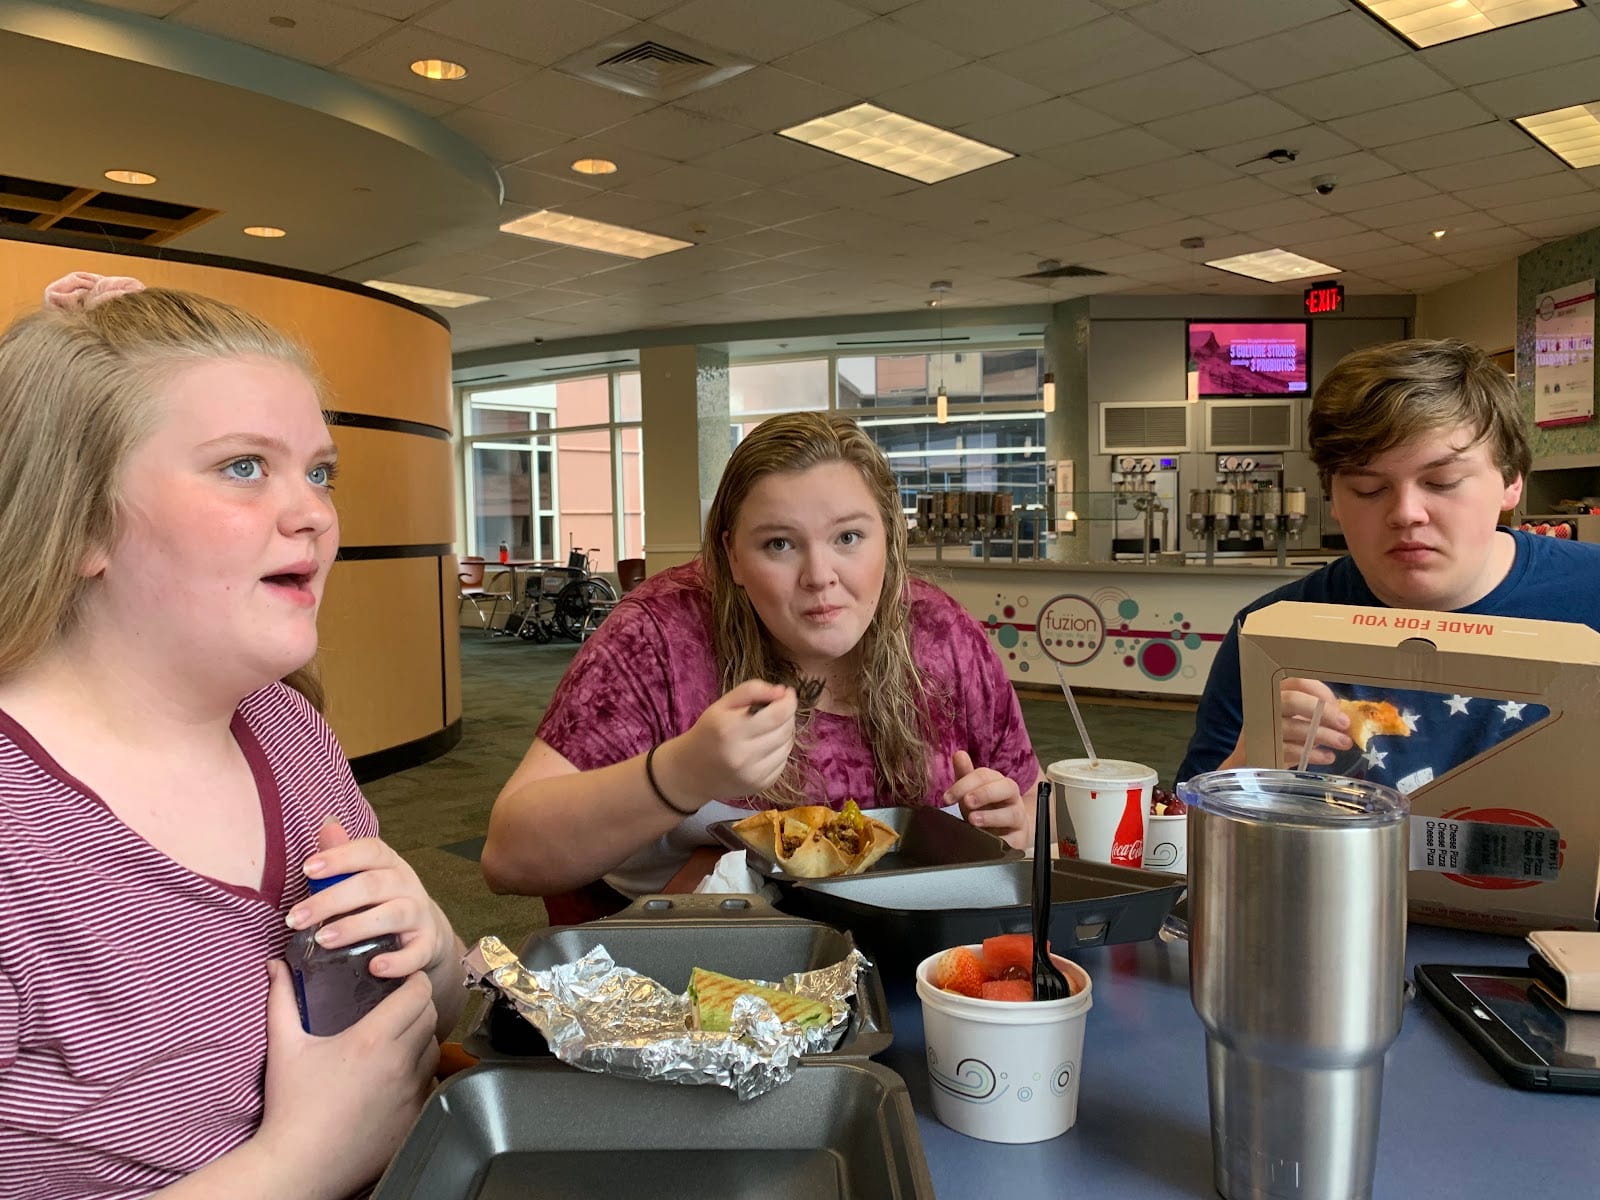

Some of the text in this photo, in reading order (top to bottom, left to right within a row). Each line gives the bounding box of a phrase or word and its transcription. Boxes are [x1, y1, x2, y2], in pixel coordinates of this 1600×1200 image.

[1310, 288, 1338, 312] EXIT
[1045, 610, 1096, 632] fuzion
[1352, 614, 1494, 635] MADE FOR YOU
[1426, 821, 1435, 865] Cheese Pizza
[1438, 823, 1446, 848] Cheese
[1450, 823, 1458, 868] Cheese Pizza
